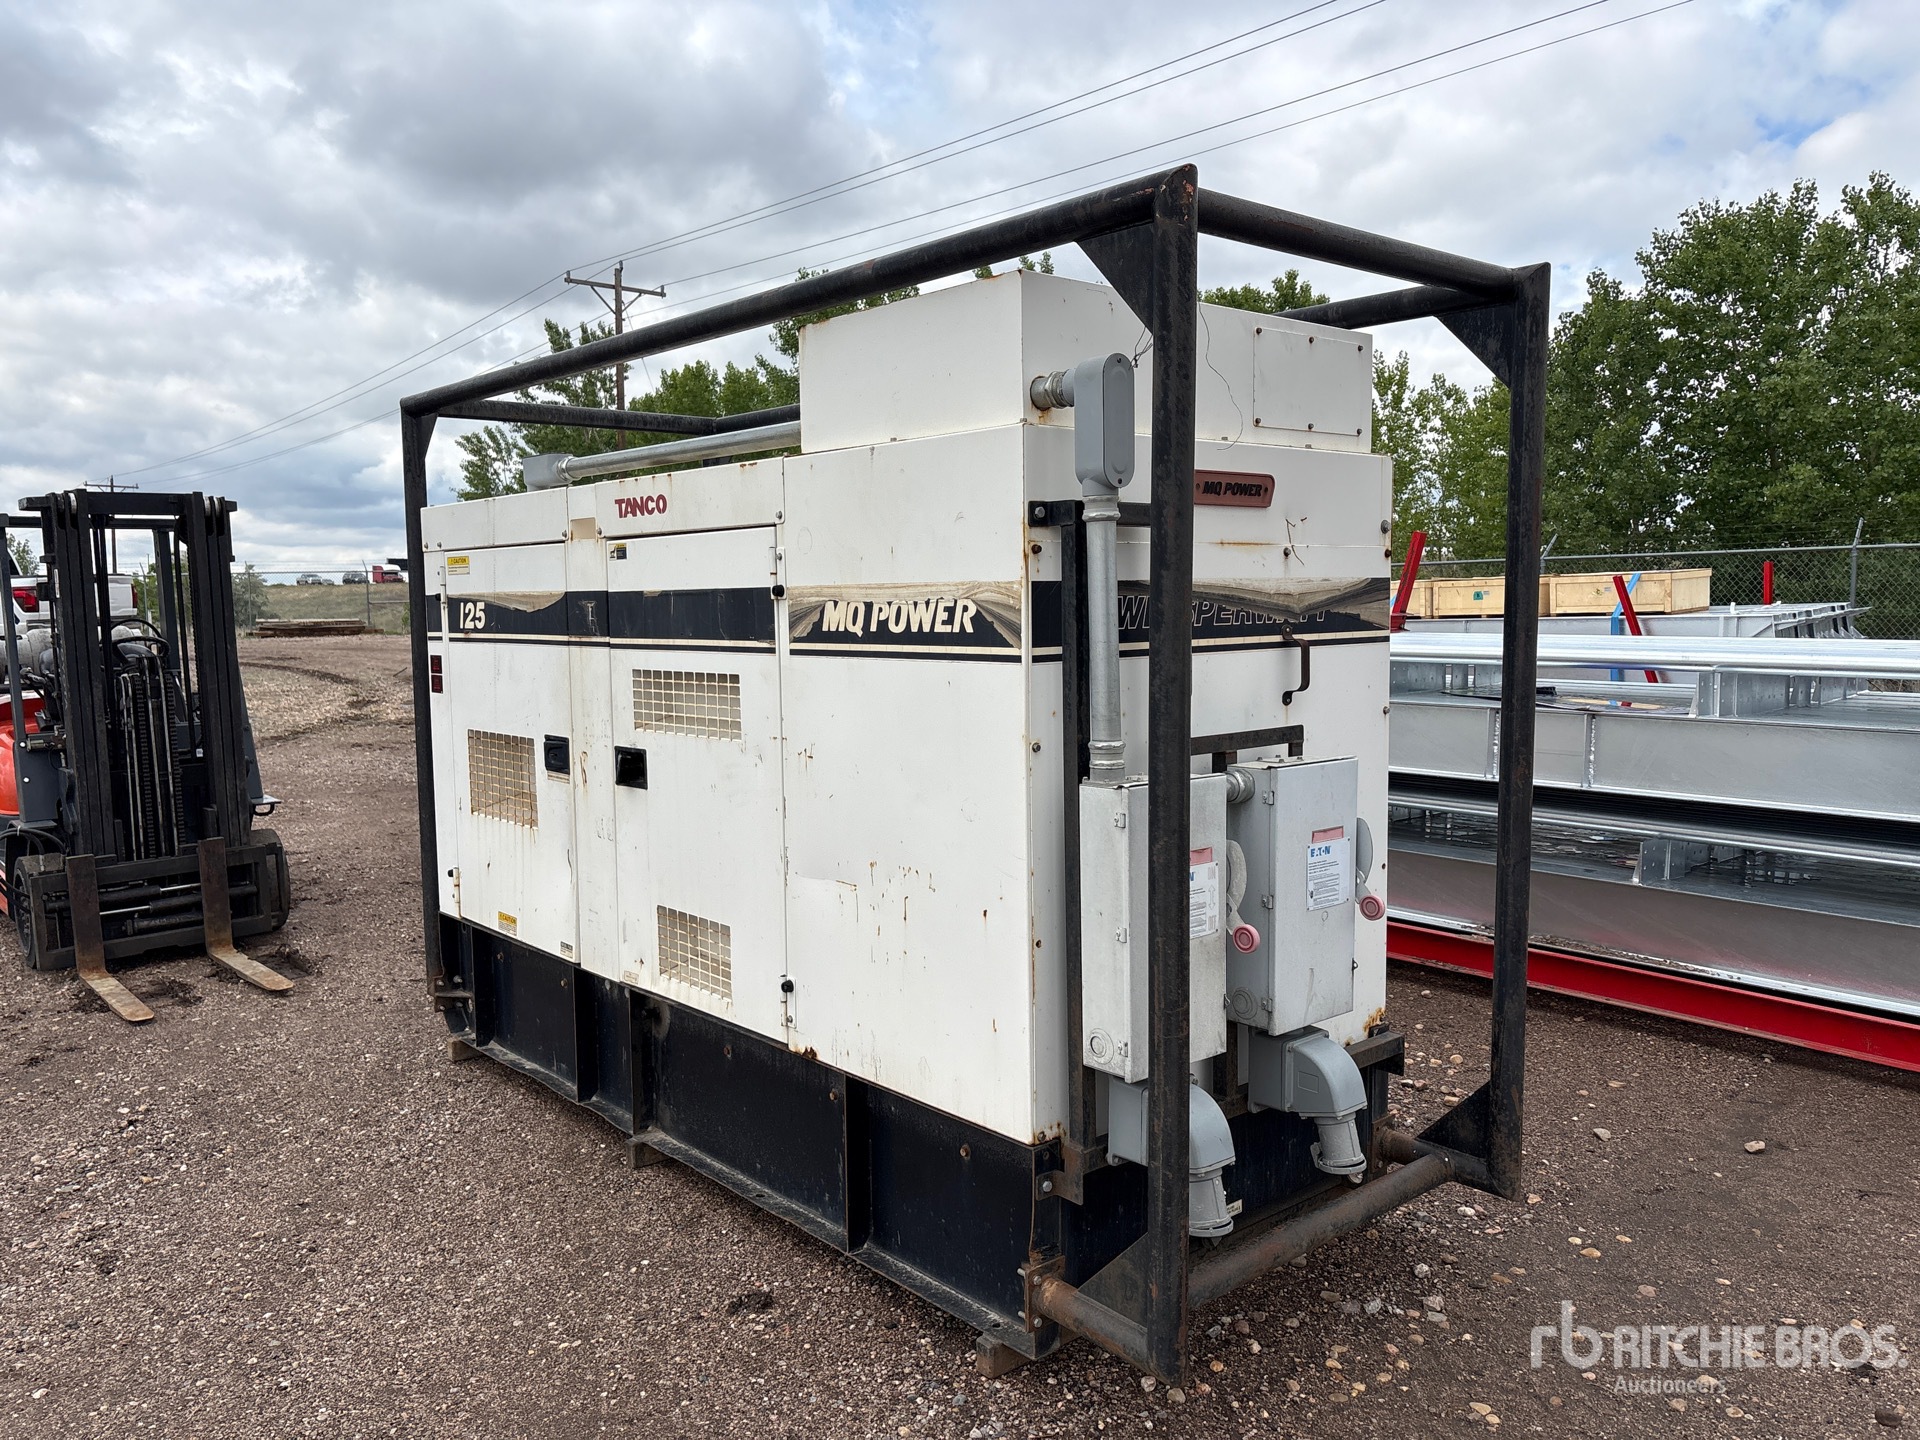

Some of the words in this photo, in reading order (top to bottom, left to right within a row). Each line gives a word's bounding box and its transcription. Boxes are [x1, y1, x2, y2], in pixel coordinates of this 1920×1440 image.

[1202, 481, 1222, 496] MQ
[1223, 482, 1263, 497] POWER
[614, 494, 668, 519] TANCO
[459, 601, 486, 629] 125
[822, 600, 865, 638] MQ
[869, 598, 977, 634] POWER
